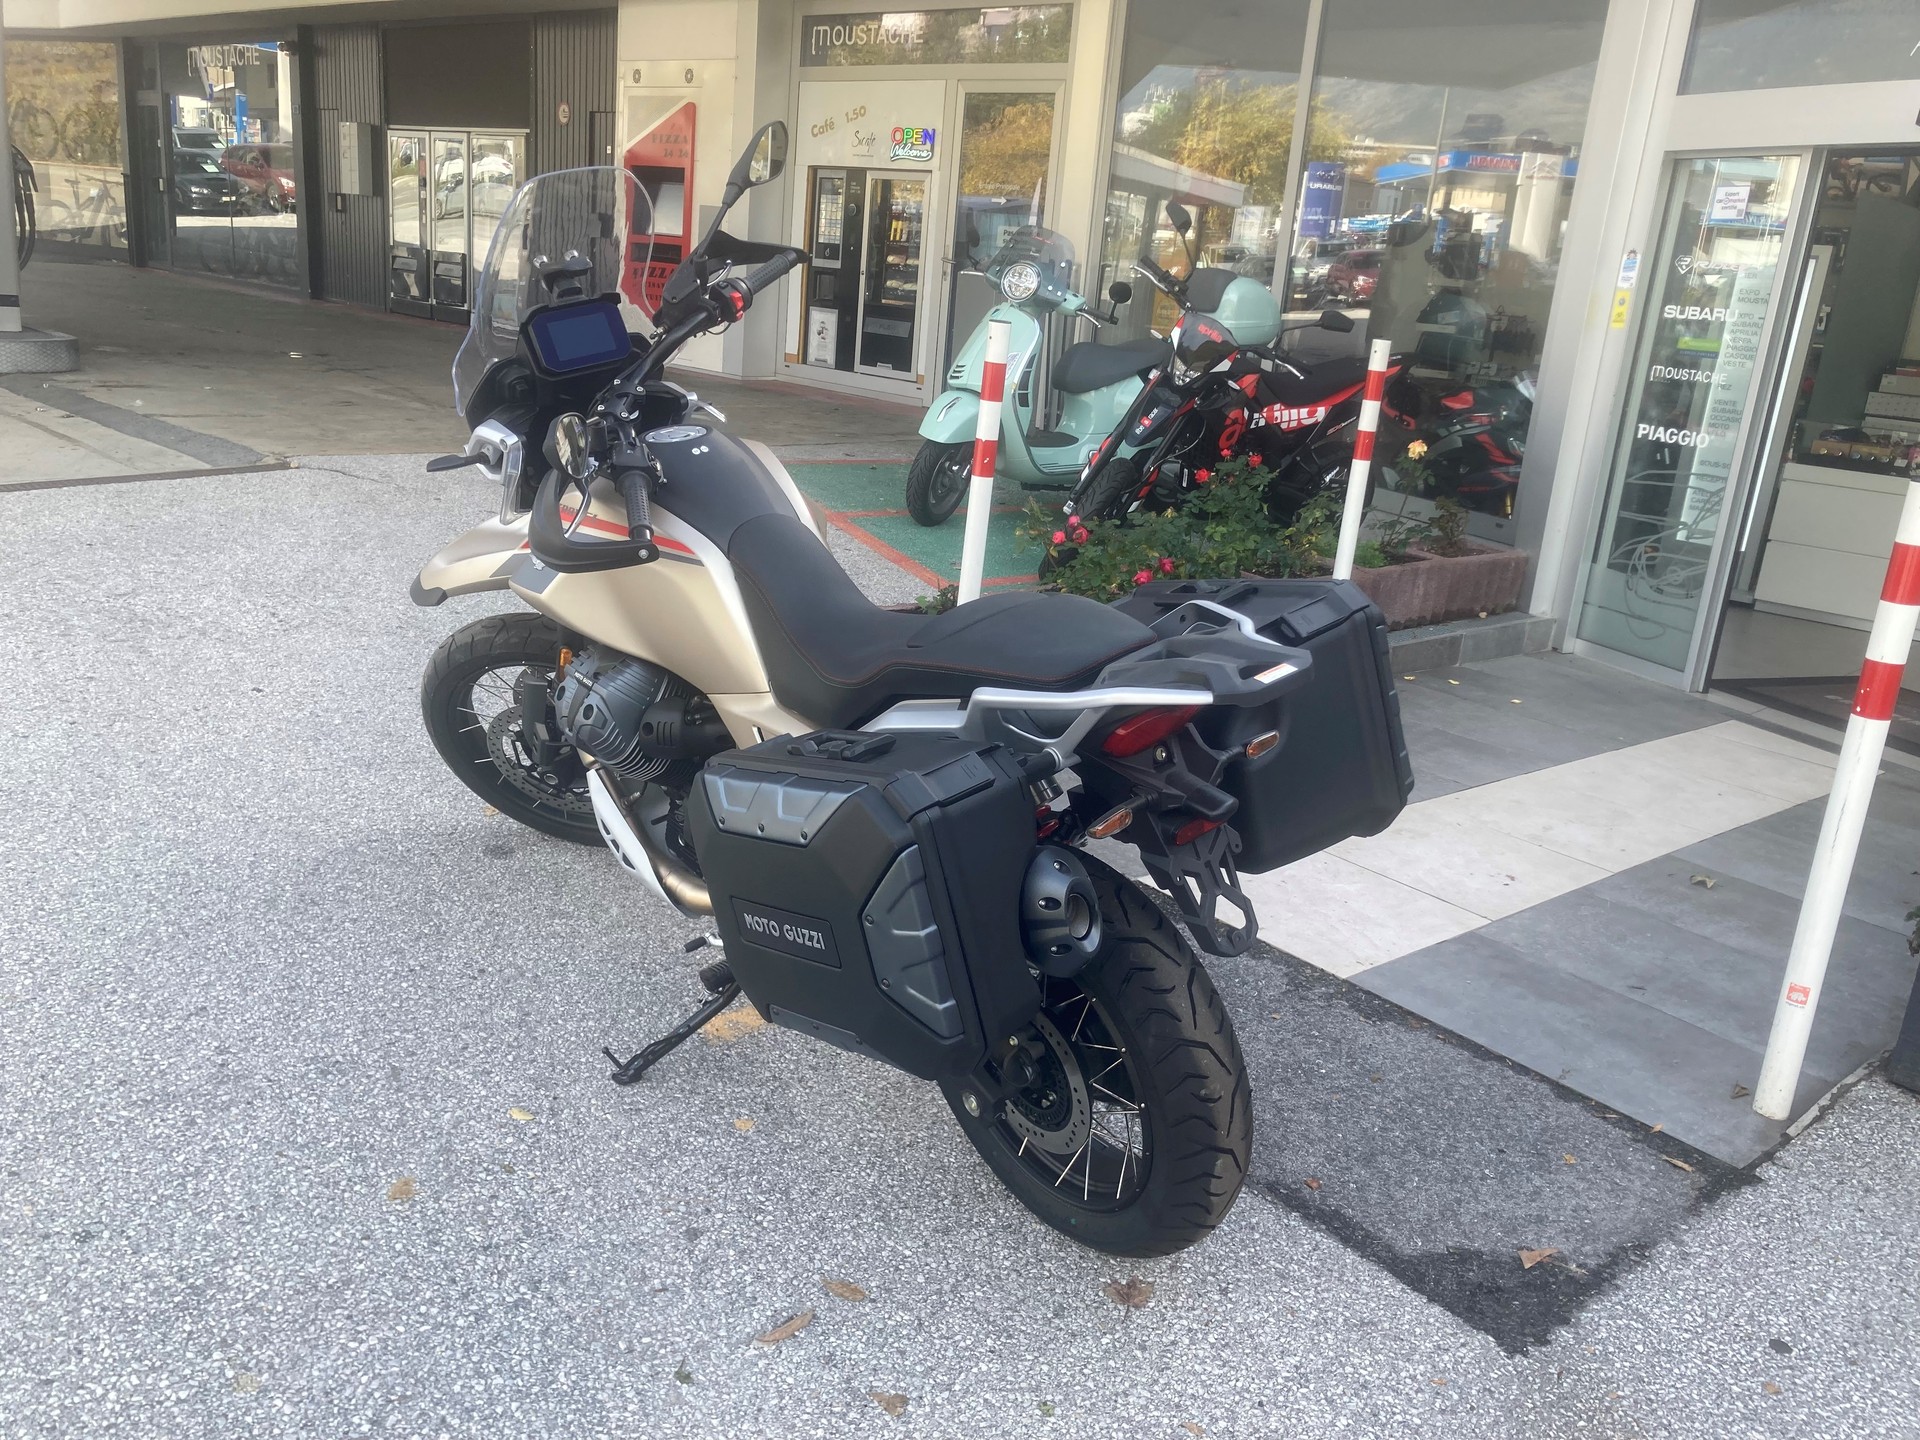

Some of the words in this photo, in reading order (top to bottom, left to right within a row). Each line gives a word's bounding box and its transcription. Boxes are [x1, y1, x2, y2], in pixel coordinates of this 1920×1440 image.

[811, 25, 924, 55] MOUSTACHE
[188, 45, 261, 76] MOUSTACHE
[811, 117, 835, 138] Café
[845, 105, 867, 124] 1.50
[651, 133, 689, 145] PIZZA
[891, 127, 936, 145] OPEN
[890, 143, 932, 161] Welcome
[1664, 305, 1739, 322] SUBARU
[1737, 312, 1755, 320] XPO
[1730, 328, 1758, 336] APRILIA
[1732, 321, 1762, 329] SUBARU
[1197, 323, 1223, 344] aprilia
[1726, 344, 1757, 352] PIAGGIO
[1724, 352, 1756, 361] CASQUE
[1723, 360, 1748, 369] VESTE
[1650, 365, 1728, 385] MOUSTACHE
[1714, 399, 1738, 407] VENTE
[1712, 407, 1743, 416] SUBARU
[1708, 422, 1730, 430] MOTO
[1637, 423, 1710, 448] PIAGGIO
[743, 912, 780, 938] MOTO
[783, 924, 826, 950] GUZZI
